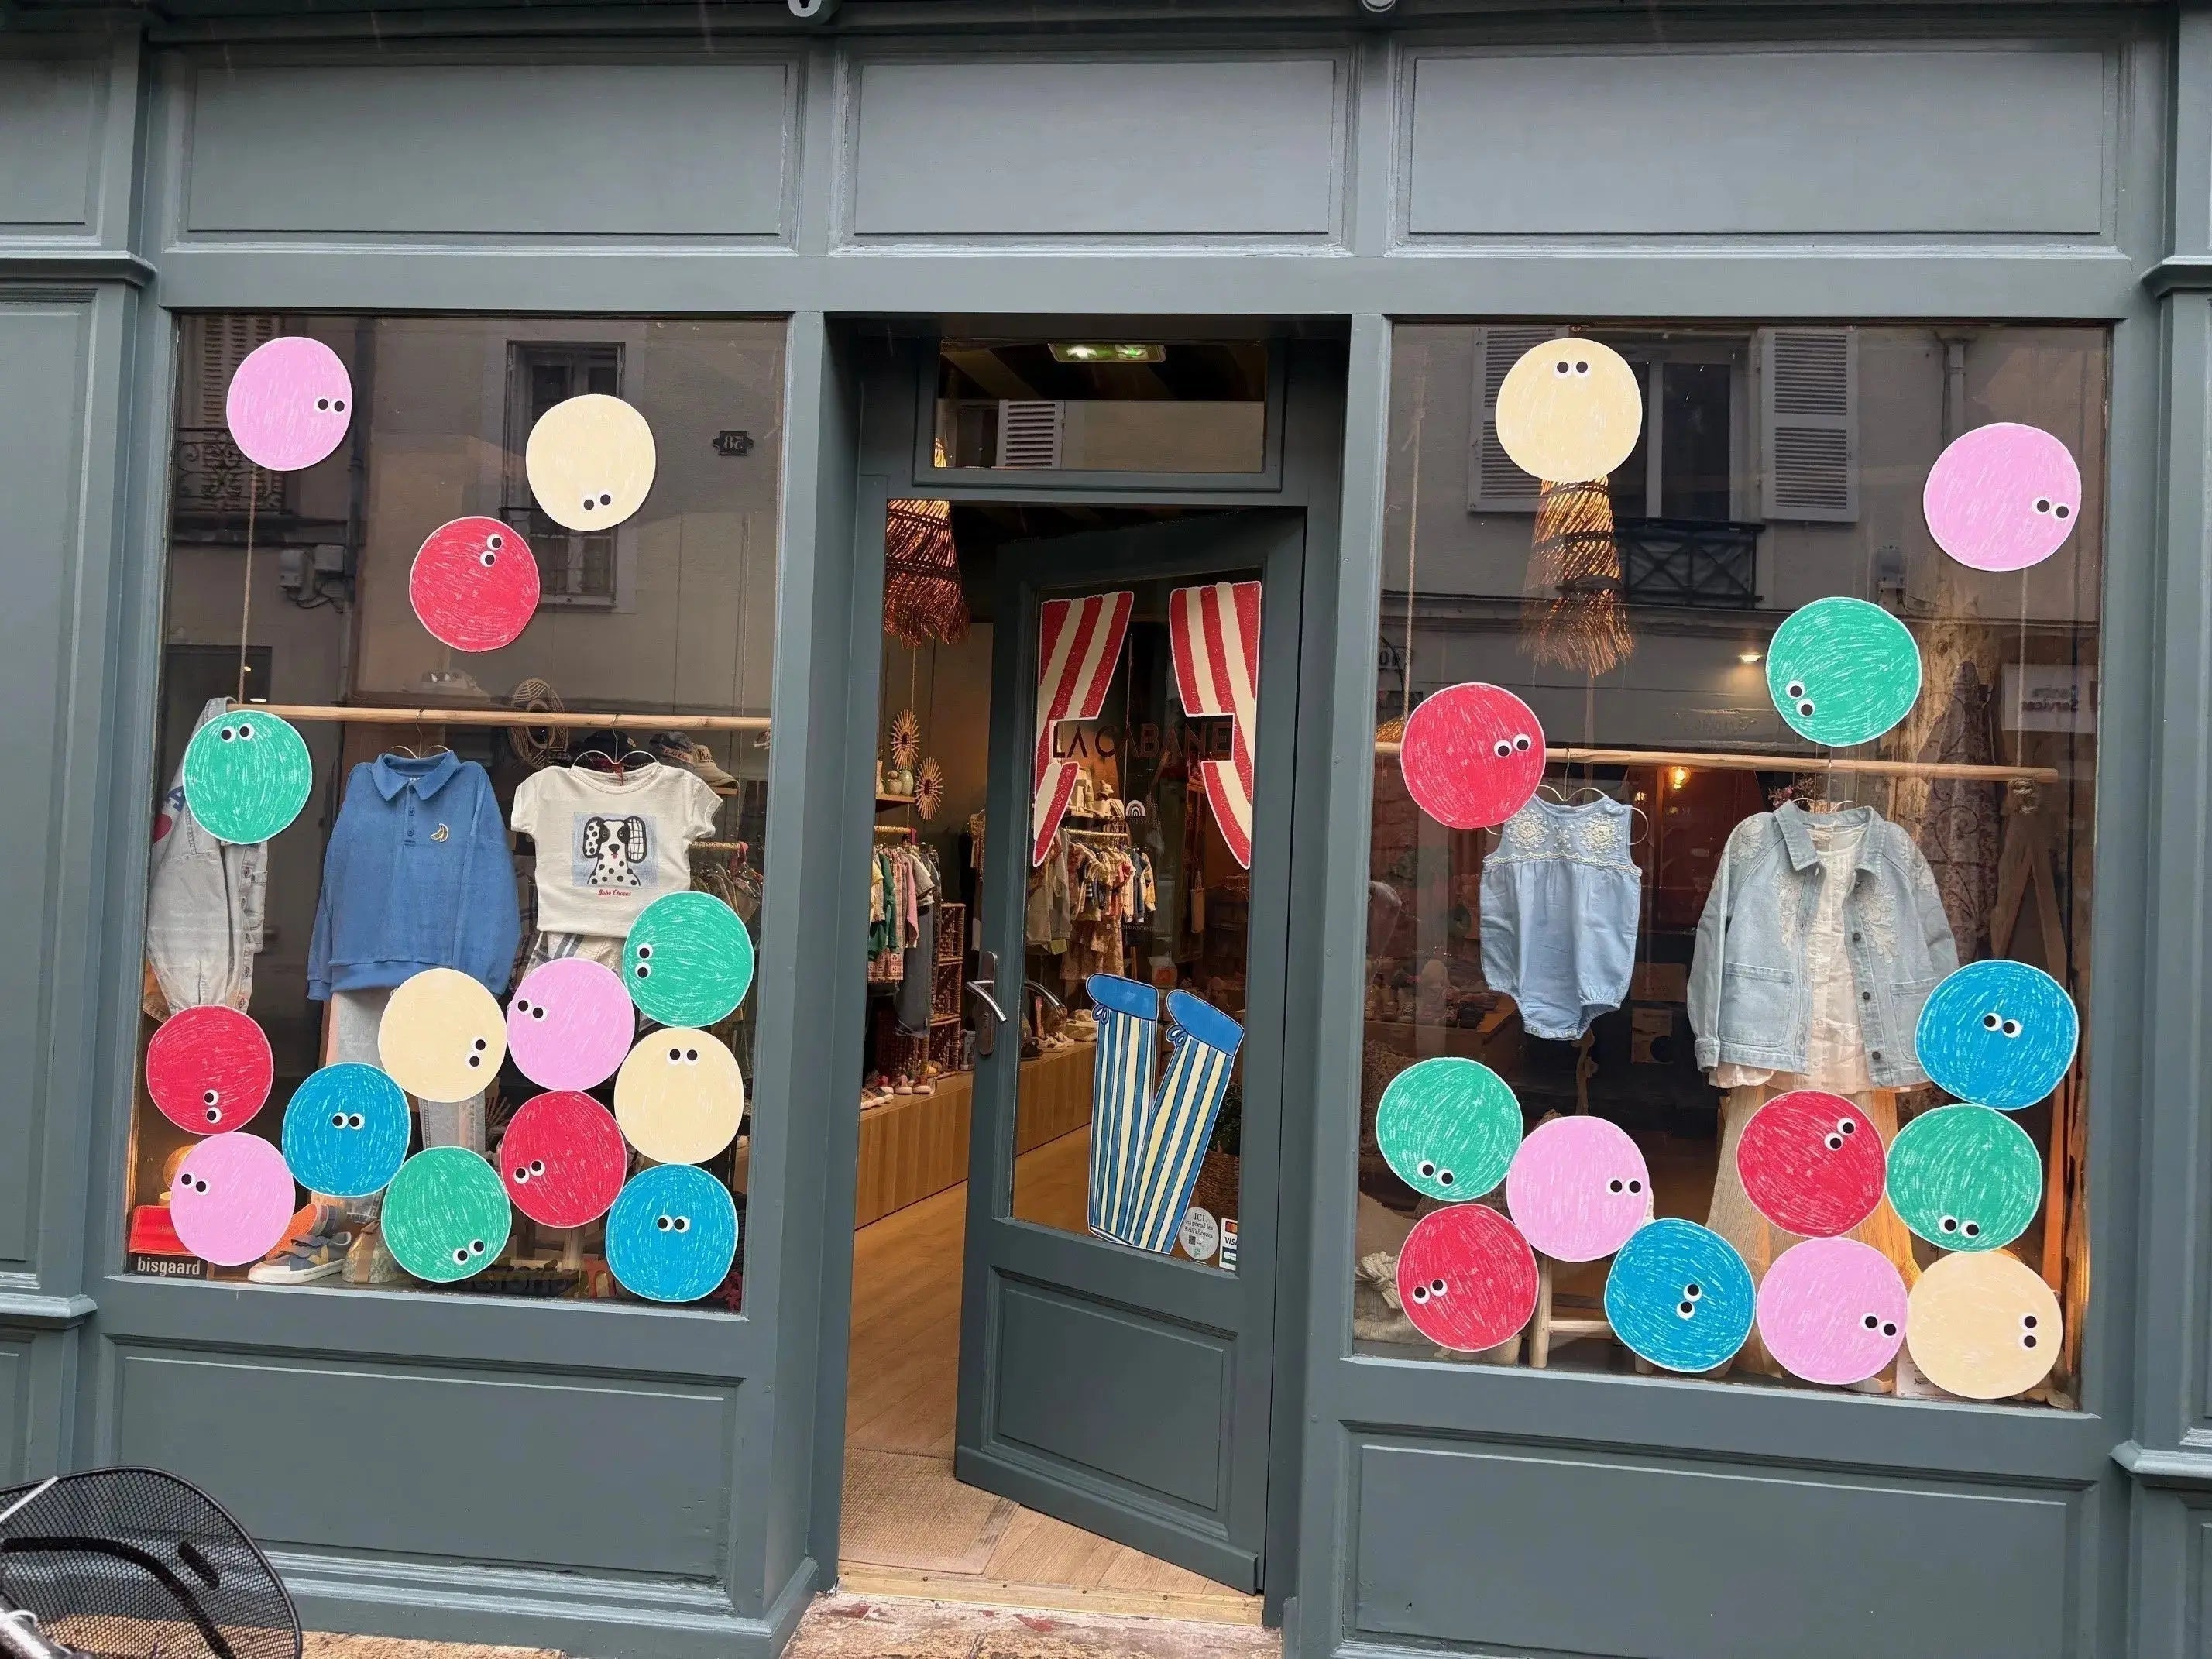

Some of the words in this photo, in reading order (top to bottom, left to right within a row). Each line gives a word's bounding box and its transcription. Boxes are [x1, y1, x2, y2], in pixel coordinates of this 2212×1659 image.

[1053, 725, 1088, 758] LA
[1094, 721, 1233, 758] CABANE
[137, 1256, 201, 1276] bisgaard
